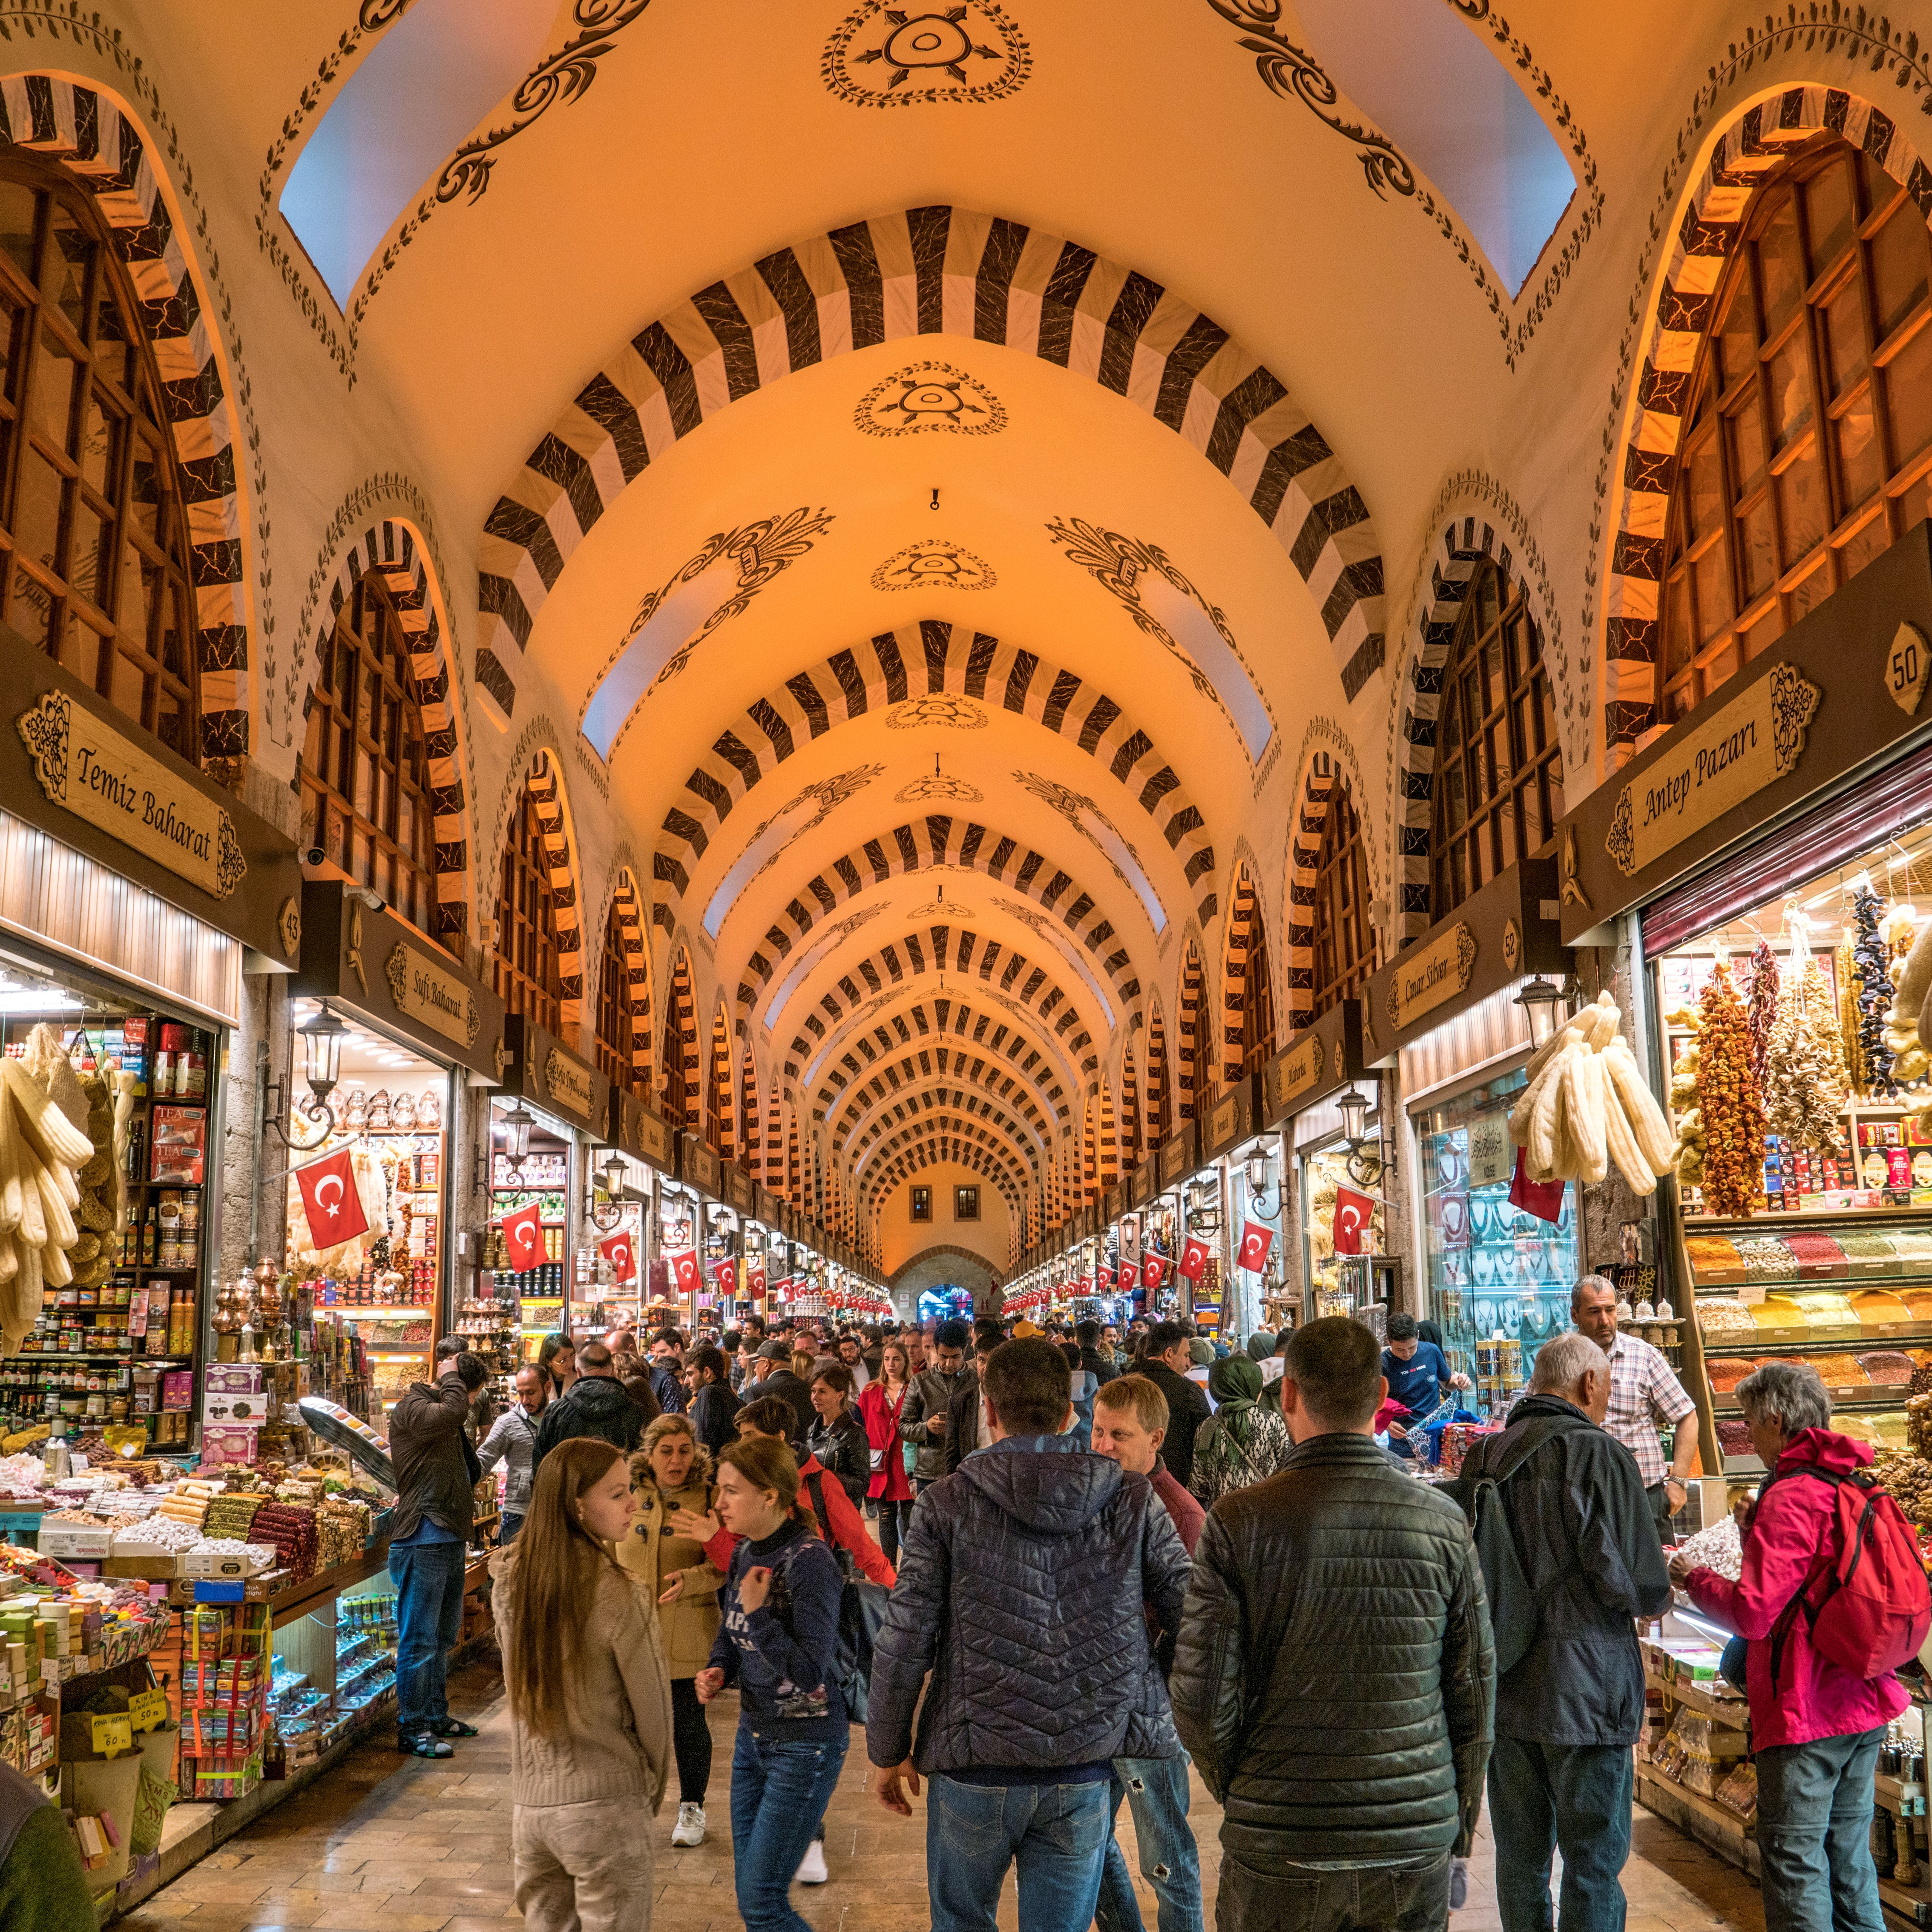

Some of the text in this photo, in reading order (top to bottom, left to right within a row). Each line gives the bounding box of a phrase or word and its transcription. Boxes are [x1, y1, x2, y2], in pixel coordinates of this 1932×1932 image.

[1893, 644, 1917, 691] 50
[1644, 720, 1757, 826] Antep Pazarı
[78, 748, 211, 861] Temiz Baharat
[287, 913, 298, 940] 43
[1505, 933, 1515, 958] 52
[1427, 956, 1448, 989] Silver
[414, 970, 461, 1019] Sufi Baharat
[498, 1048, 504, 1066] 45
[1336, 1051, 1341, 1068] 54
[556, 1064, 565, 1089] Sefa
[159, 1108, 183, 1119] TEA
[158, 1146, 180, 1156] TEA
[1892, 1161, 1907, 1171] filiz
[140, 1709, 151, 1721] 50
[106, 1736, 118, 1746] 60
